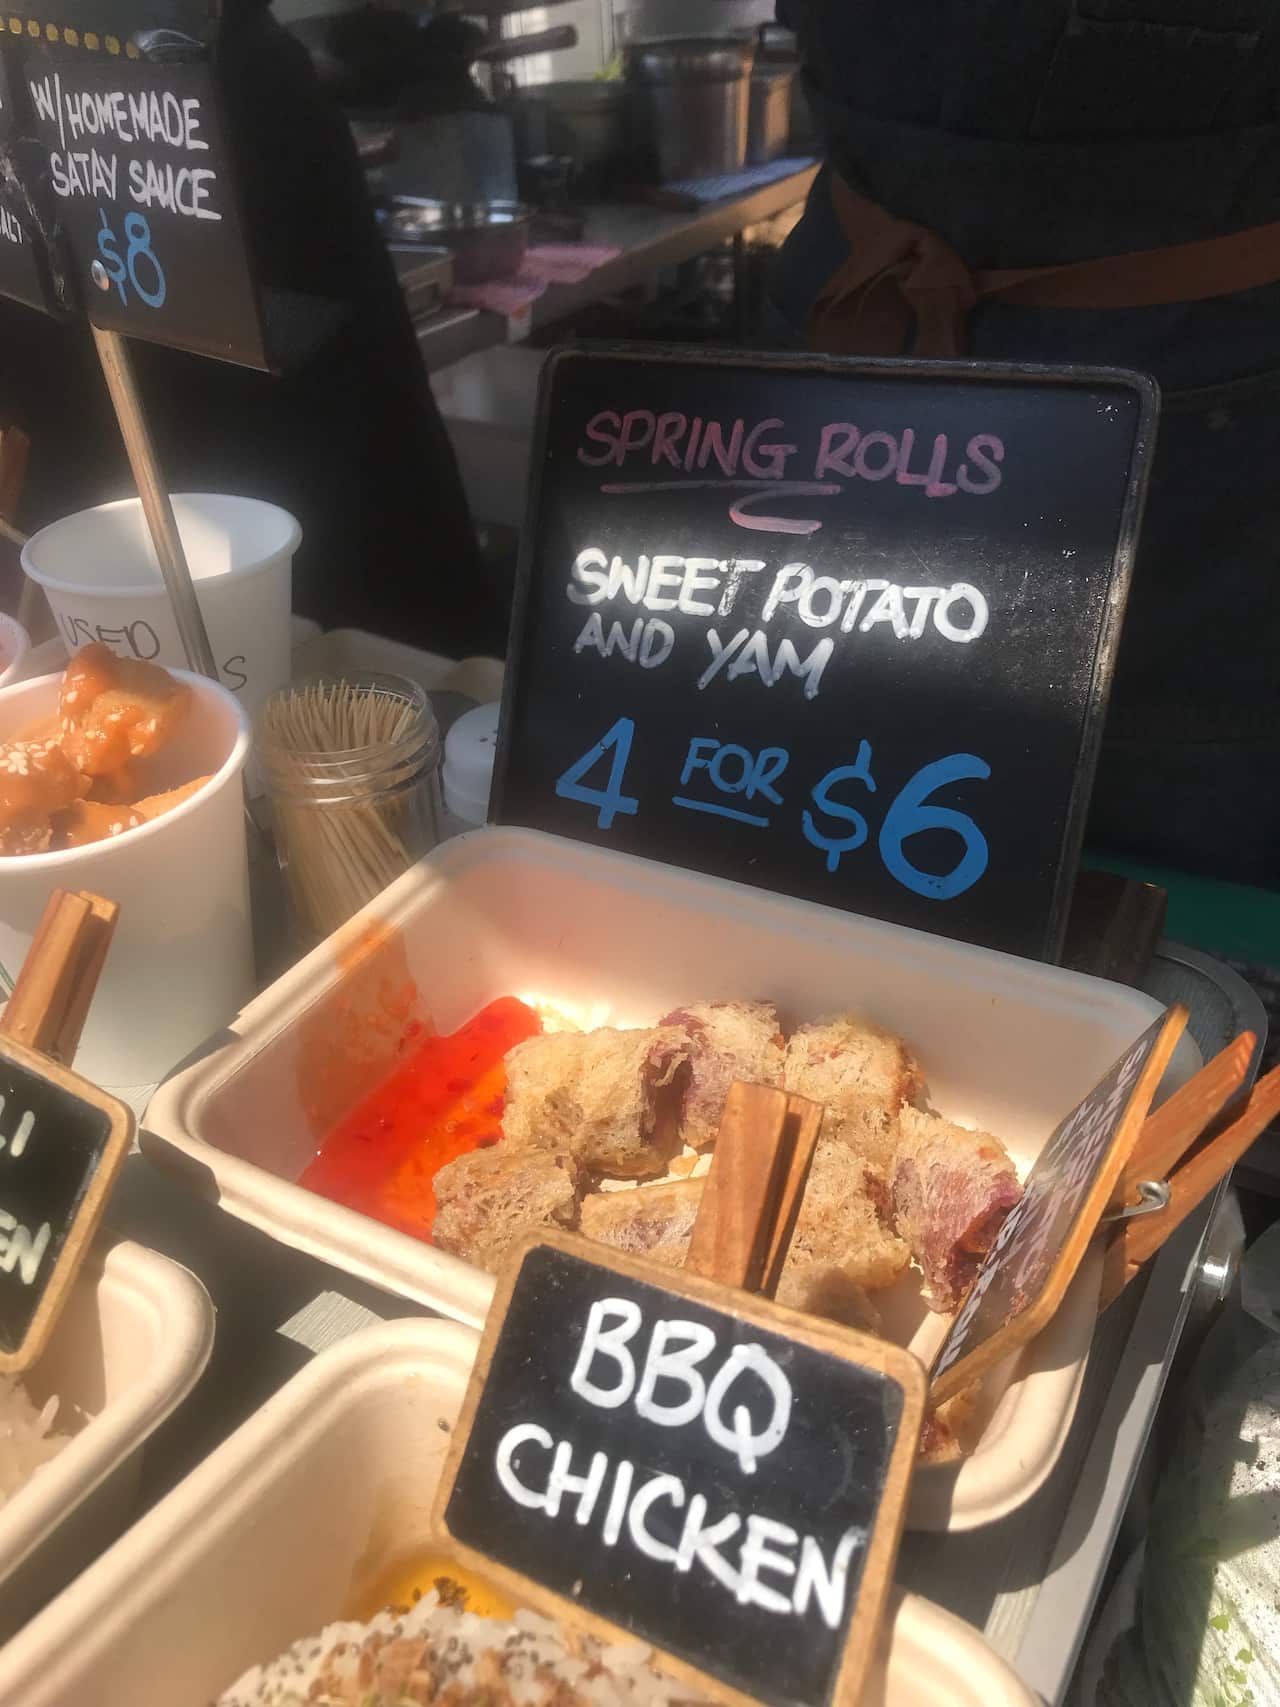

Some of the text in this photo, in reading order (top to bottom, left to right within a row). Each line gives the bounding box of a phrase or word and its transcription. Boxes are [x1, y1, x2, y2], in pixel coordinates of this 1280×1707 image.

[51, 148, 222, 220] SATAY SAUCE
[97, 208, 165, 308] $8
[577, 410, 1005, 498] SPRING ROLLS
[567, 548, 989, 643] SWEET POTATO
[574, 612, 834, 699] AND YAM
[556, 716, 991, 900] 4 FOR $6
[571, 1298, 792, 1474] BBQ
[496, 1423, 867, 1629] CHICKEN
